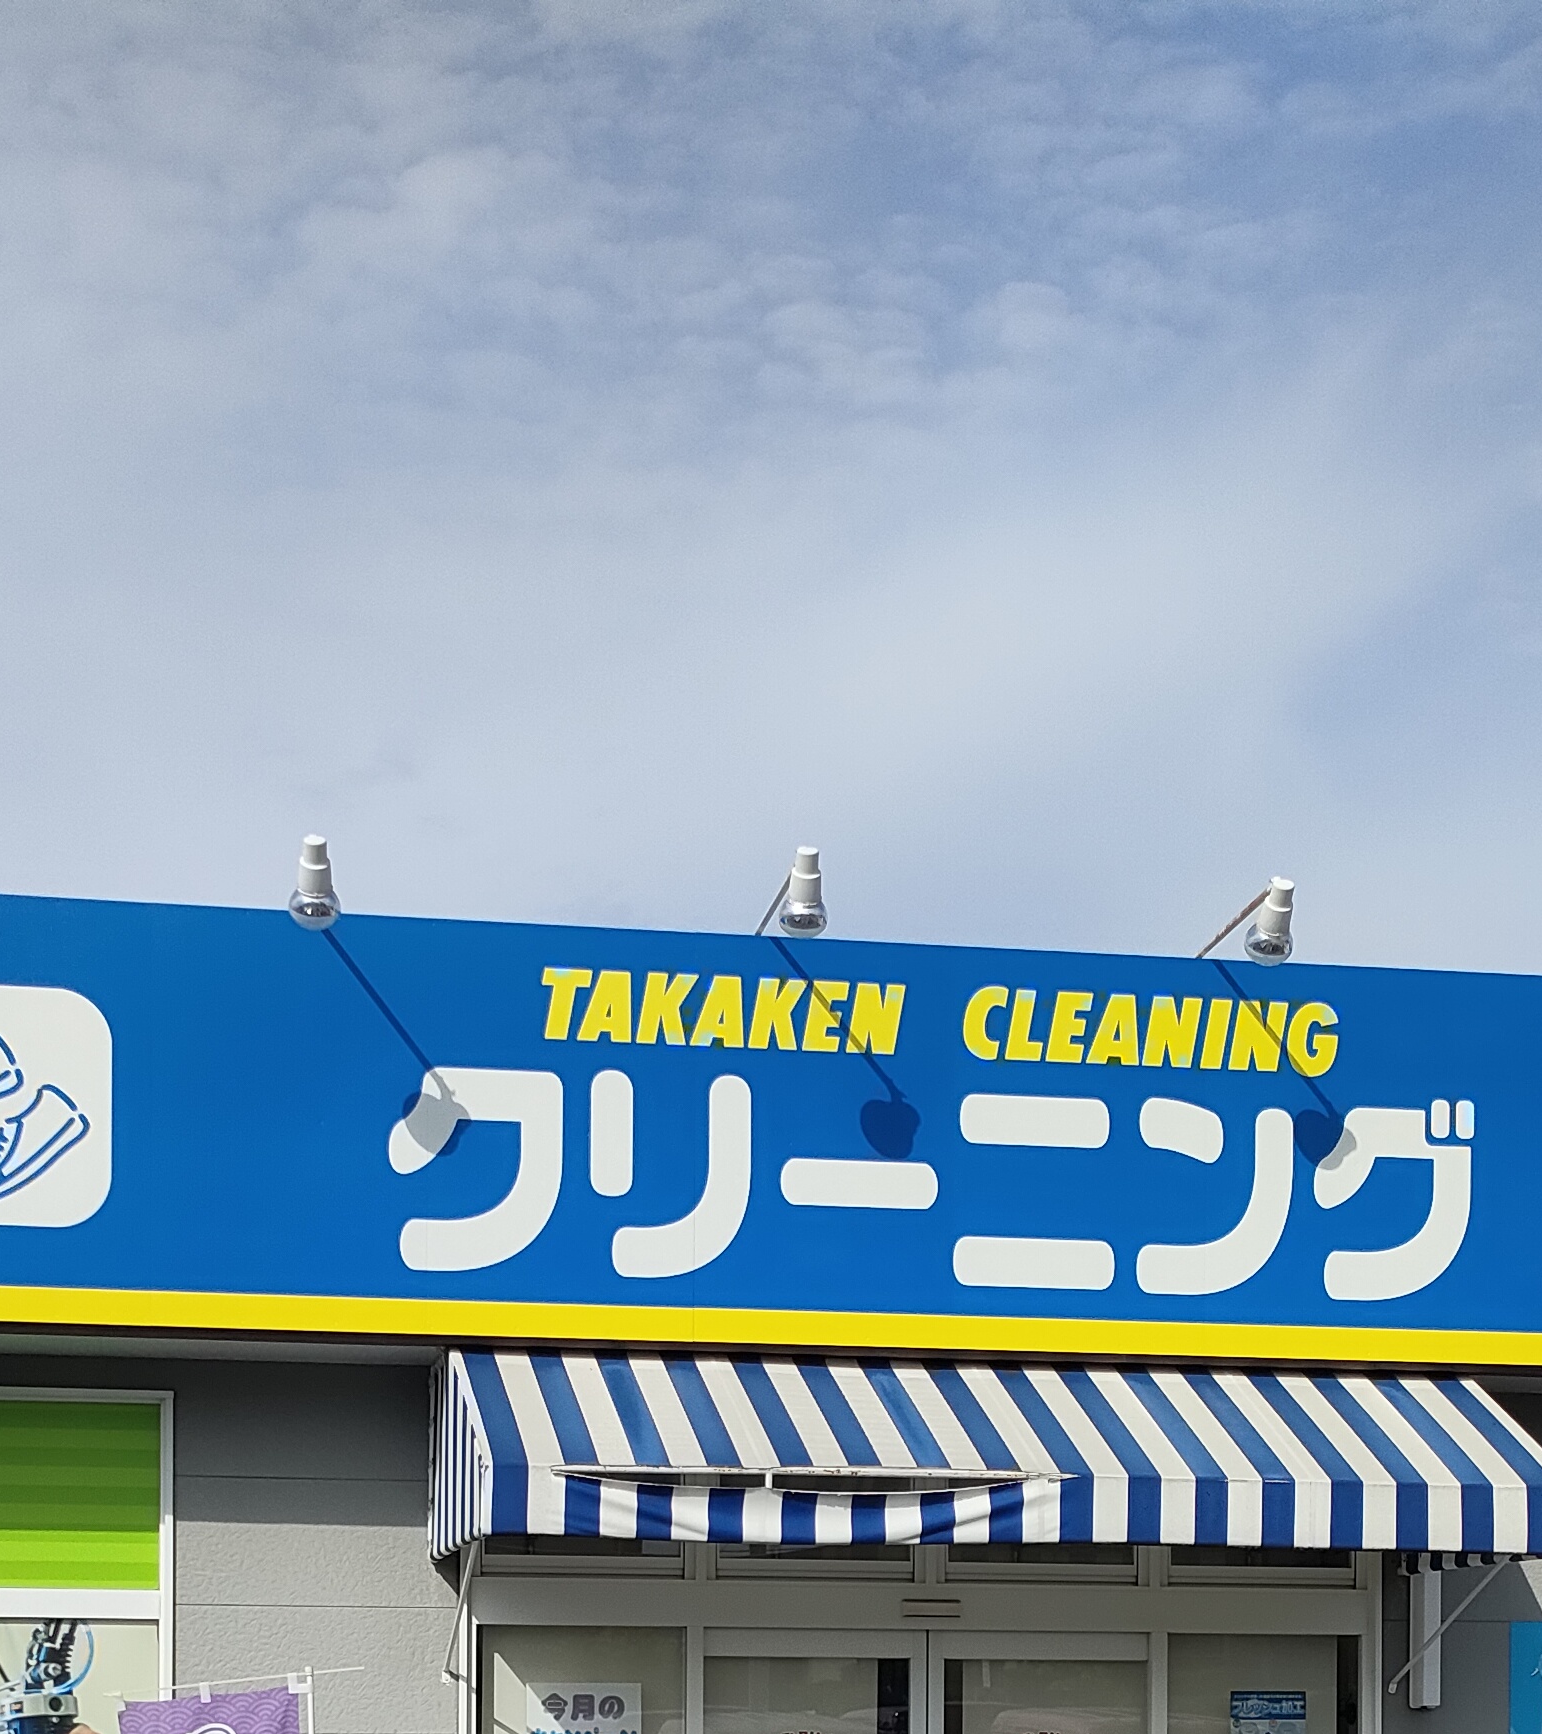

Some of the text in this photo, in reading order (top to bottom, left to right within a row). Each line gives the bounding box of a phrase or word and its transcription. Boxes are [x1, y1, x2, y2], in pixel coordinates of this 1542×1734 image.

[541, 966, 1340, 1077] TAKAKEN CLEANING
[388, 1067, 1474, 1302] クリーニング
[541, 1692, 626, 1722] 今月の
